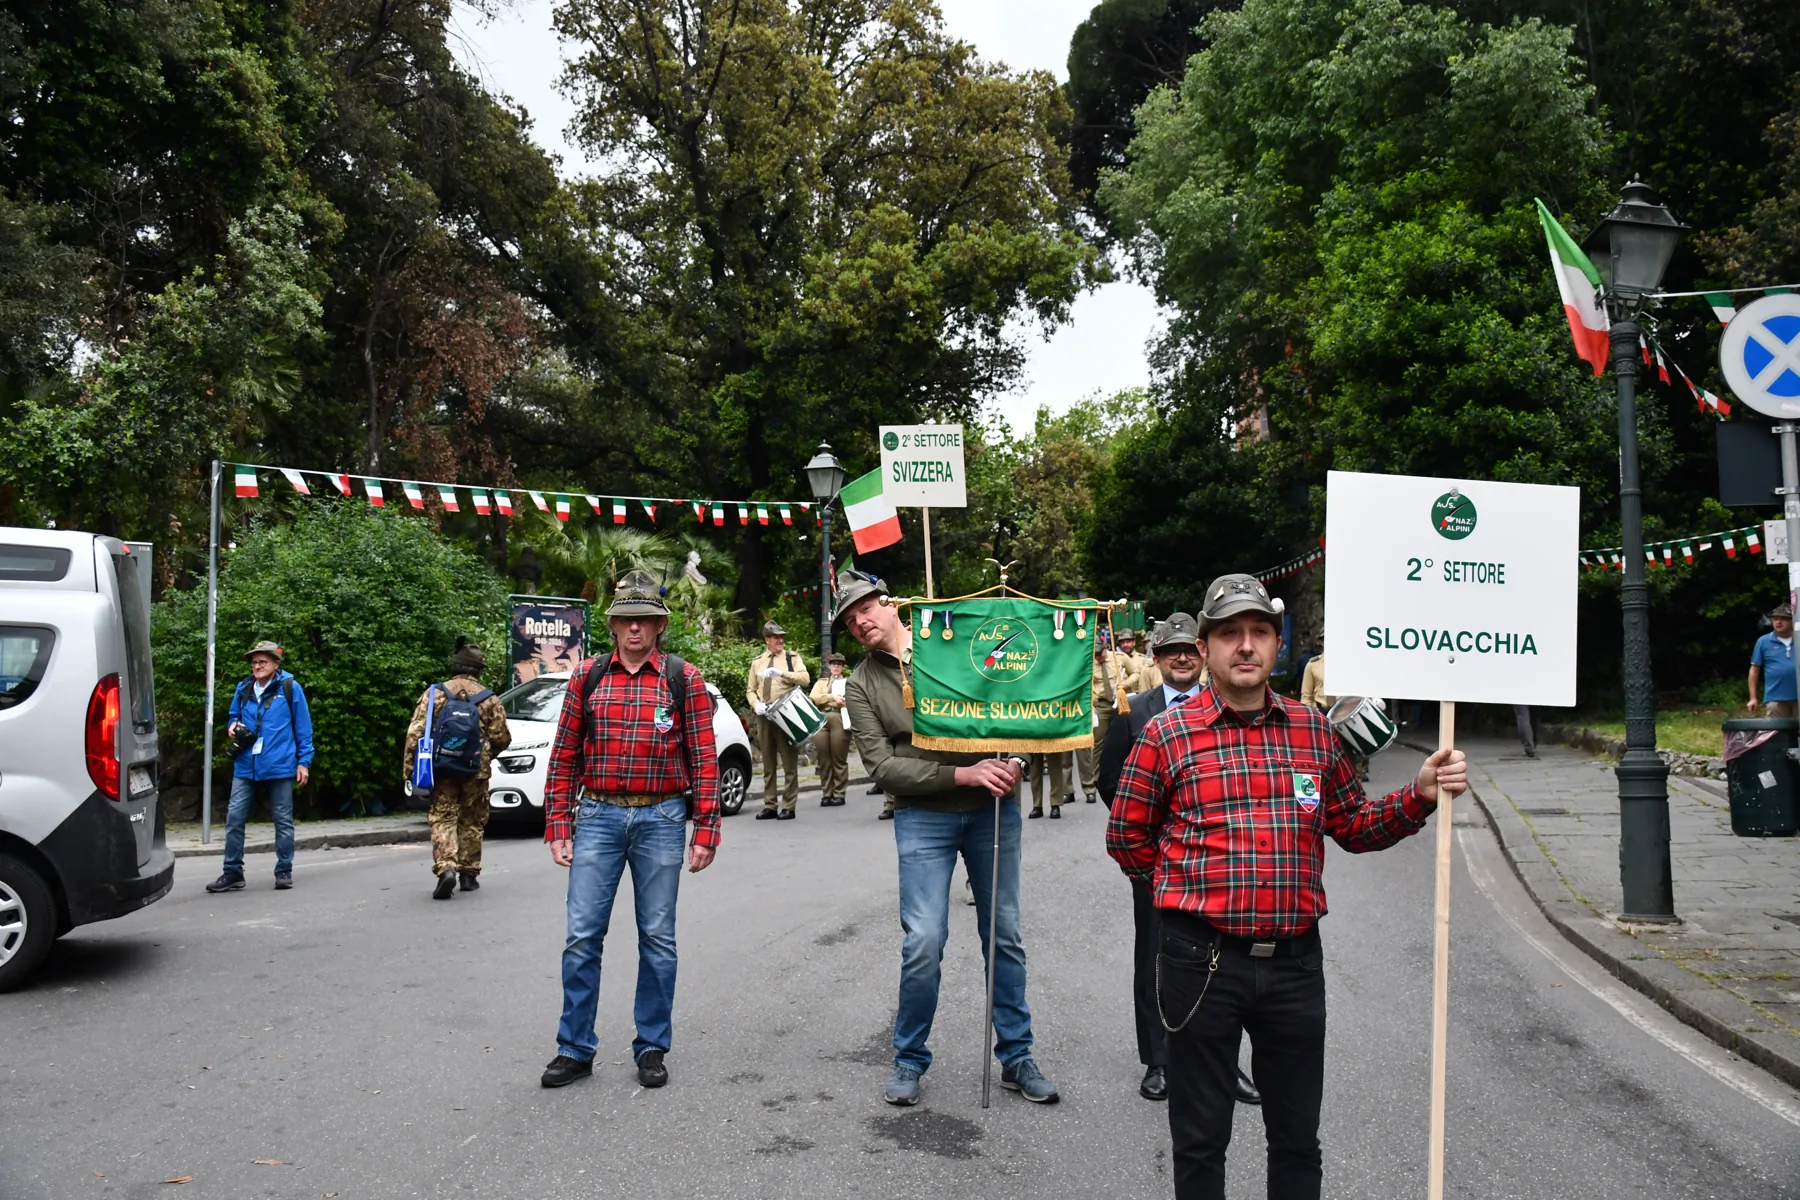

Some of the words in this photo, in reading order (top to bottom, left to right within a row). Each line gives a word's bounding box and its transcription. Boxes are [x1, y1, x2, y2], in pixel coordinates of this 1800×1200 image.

[914, 433, 960, 447] SETTORE
[892, 461, 953, 482] SVIZZERA
[1446, 524, 1471, 533] ALPINI
[1407, 557, 1434, 582] 2°
[1443, 560, 1506, 585] SETTORE
[525, 616, 571, 637] Rotella
[1366, 626, 1538, 655] SLOVACCHIA
[992, 661, 1027, 671] ALPINI
[920, 697, 986, 719] SEZIONE
[990, 699, 1084, 720] SLOVACCHIA
